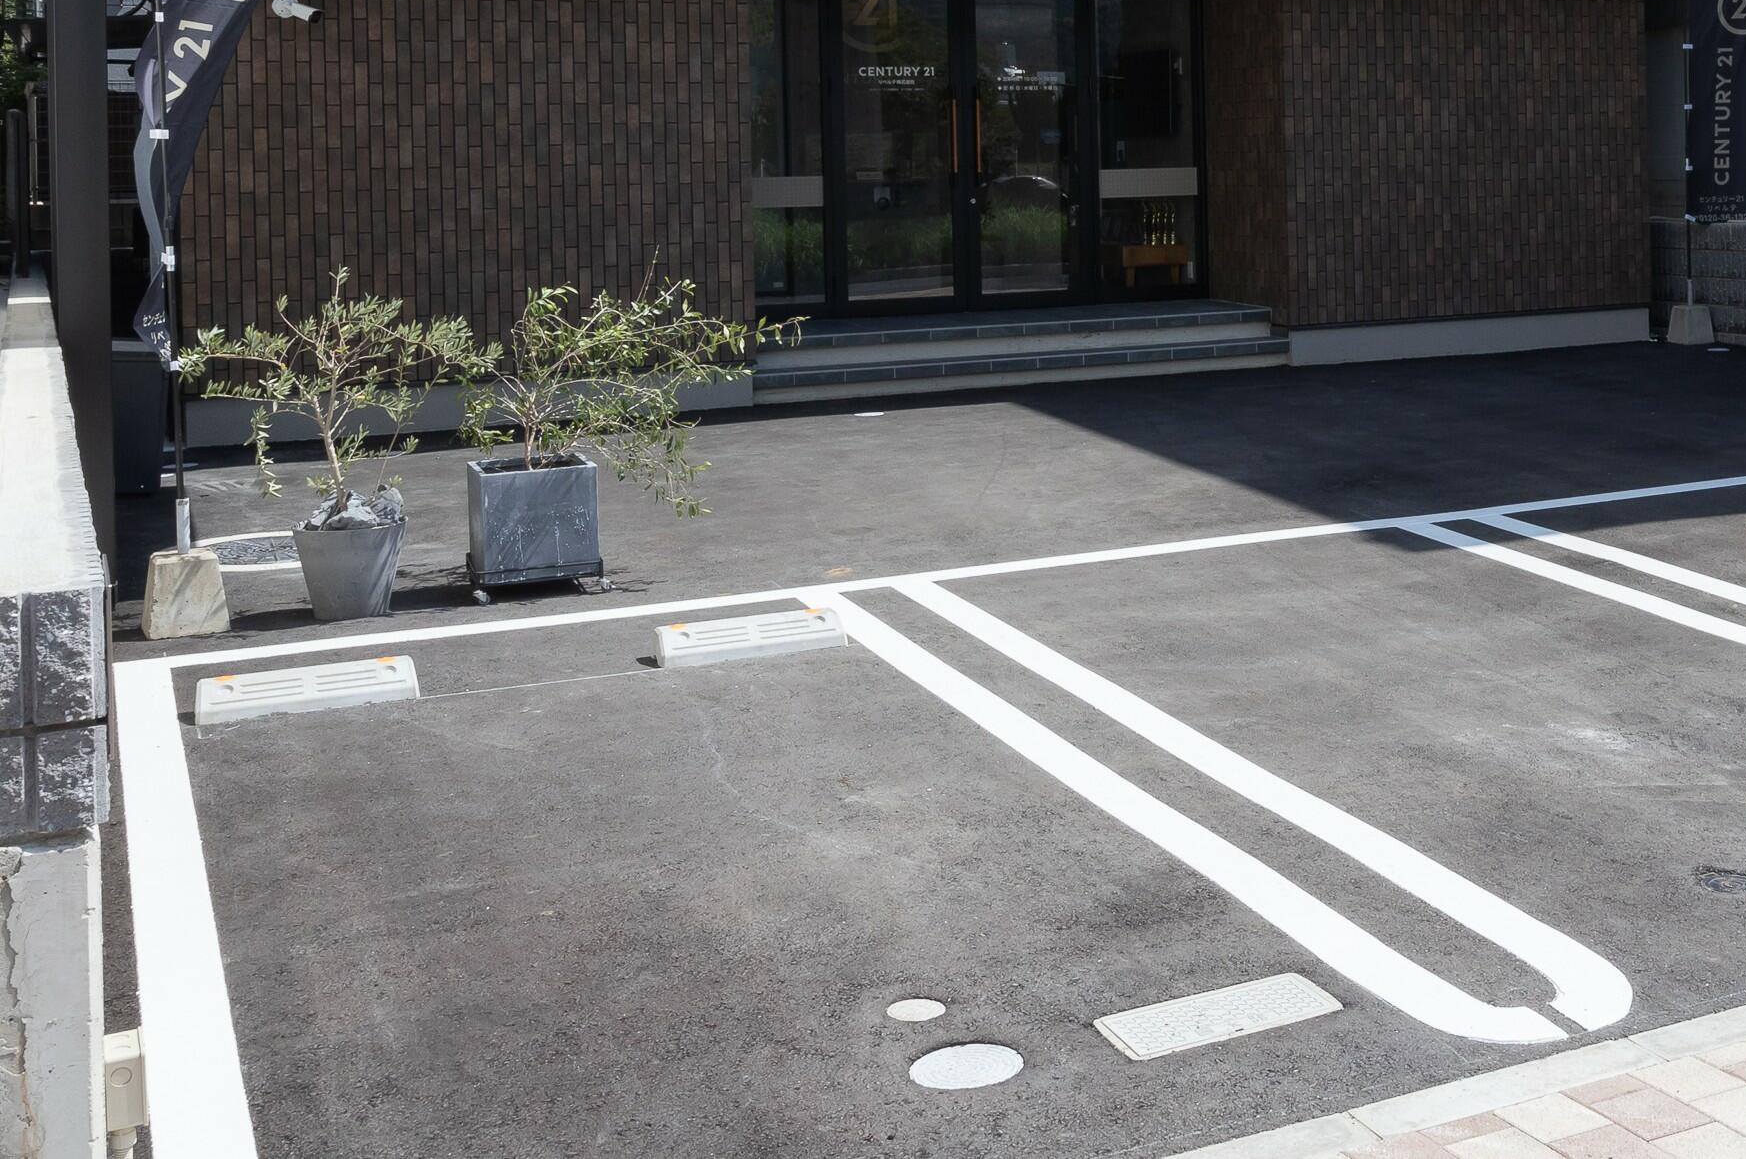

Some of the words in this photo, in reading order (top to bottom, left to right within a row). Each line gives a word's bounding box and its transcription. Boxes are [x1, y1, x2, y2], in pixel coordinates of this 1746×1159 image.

[173, 19, 214, 62] 21
[1717, 46, 1733, 67] 21
[858, 66, 921, 77] CENTURY
[923, 66, 935, 77] 21
[1714, 73, 1732, 186] CENTURY
